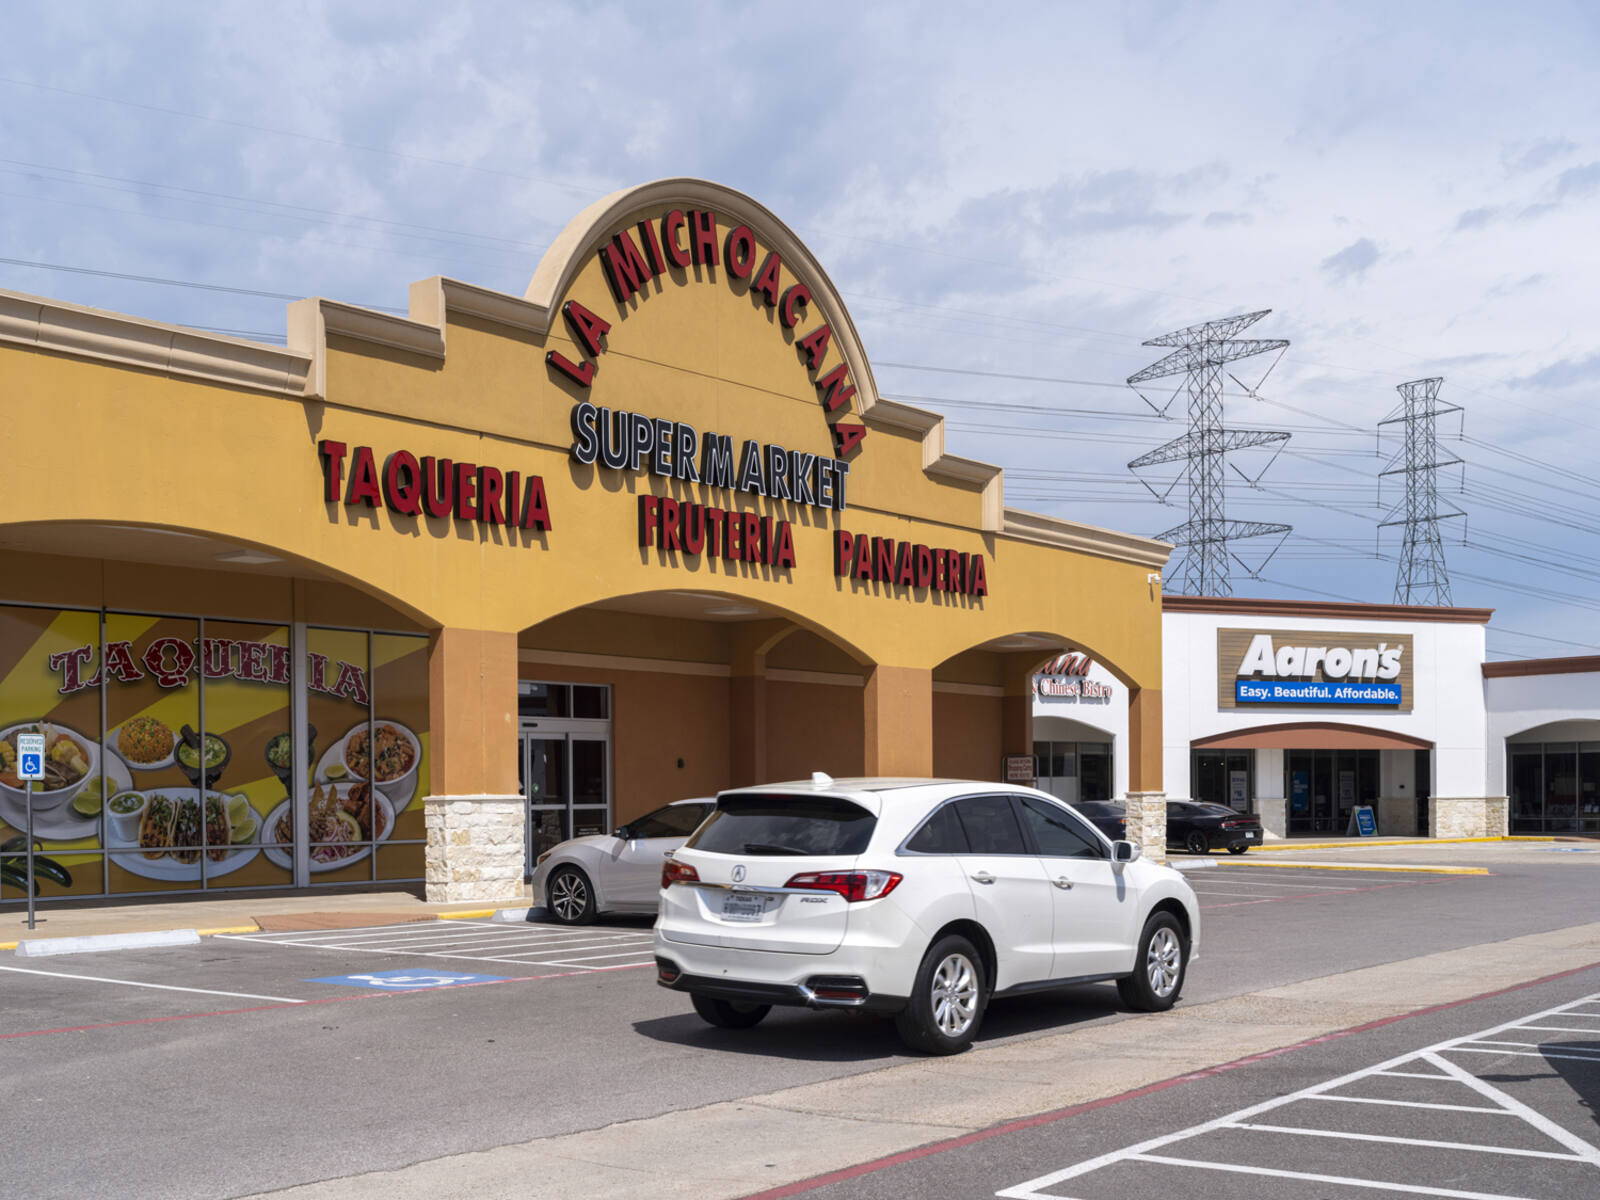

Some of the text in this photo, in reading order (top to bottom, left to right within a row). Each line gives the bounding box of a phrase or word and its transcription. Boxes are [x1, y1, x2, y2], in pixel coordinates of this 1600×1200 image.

[545, 208, 867, 458] LA MICHOACANA
[318, 439, 552, 531] TAQUERIA
[638, 494, 797, 568] FRUTERIA
[833, 530, 988, 596] PANADERIA
[50, 637, 369, 705] TAQUERIA
[1040, 678, 1080, 696] Chinese
[1082, 680, 1112, 697] Bistro
[1237, 634, 1403, 679] Aaron's
[1240, 686, 1399, 700] Easy. Beautiful. Affordable.
